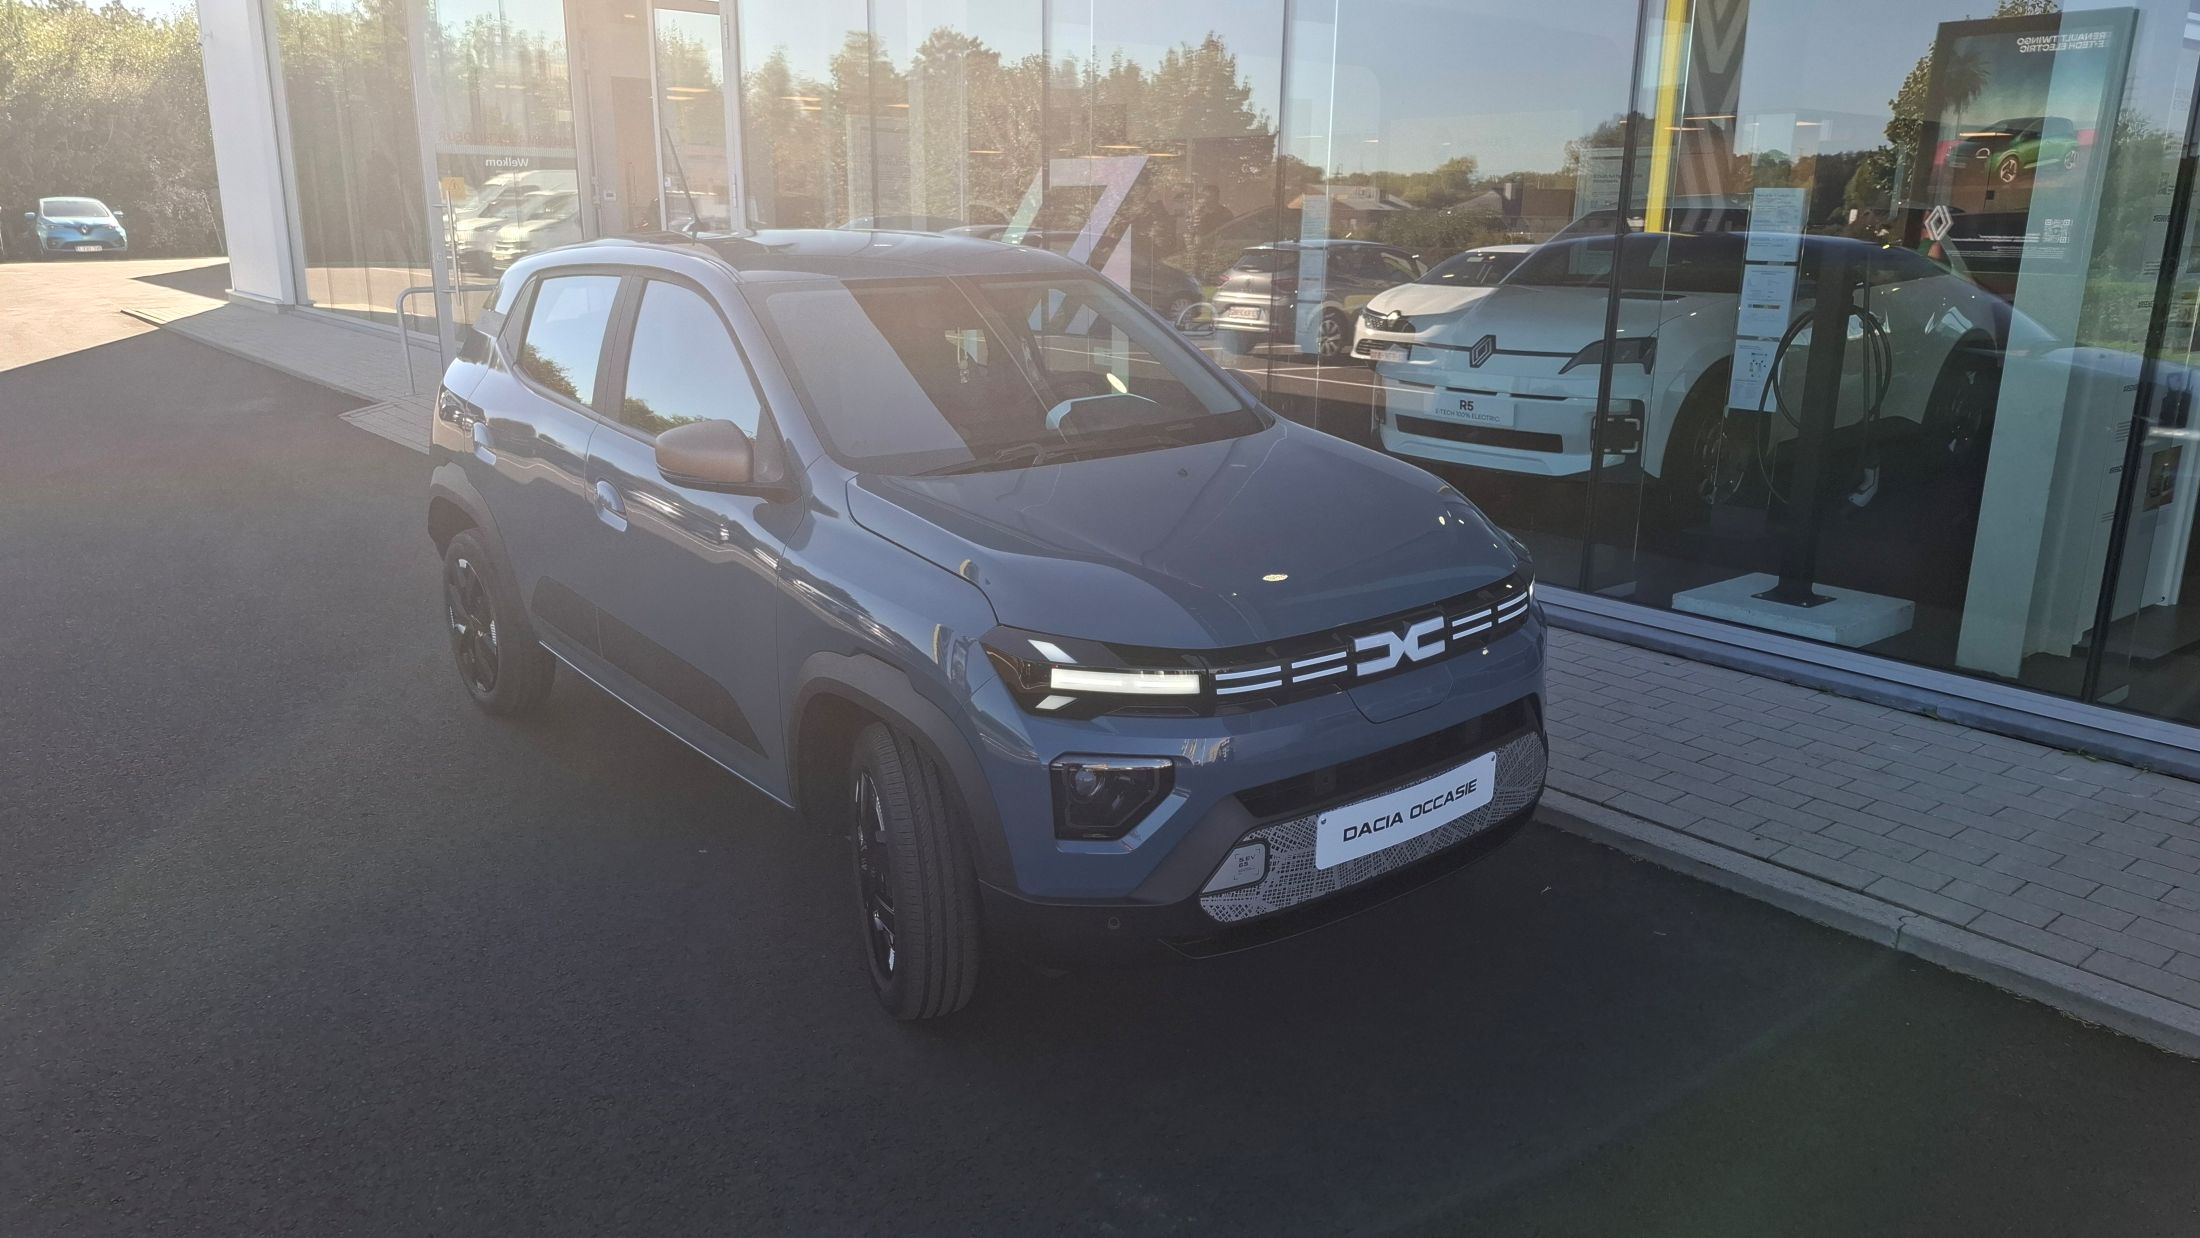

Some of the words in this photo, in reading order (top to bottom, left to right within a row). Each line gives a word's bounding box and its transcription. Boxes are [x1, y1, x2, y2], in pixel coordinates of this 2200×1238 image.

[1459, 399, 1474, 411] R5
[1471, 413, 1501, 423] ELECTRIC
[1343, 811, 1404, 842] DACIA
[1409, 778, 1478, 820] OCCASIE
